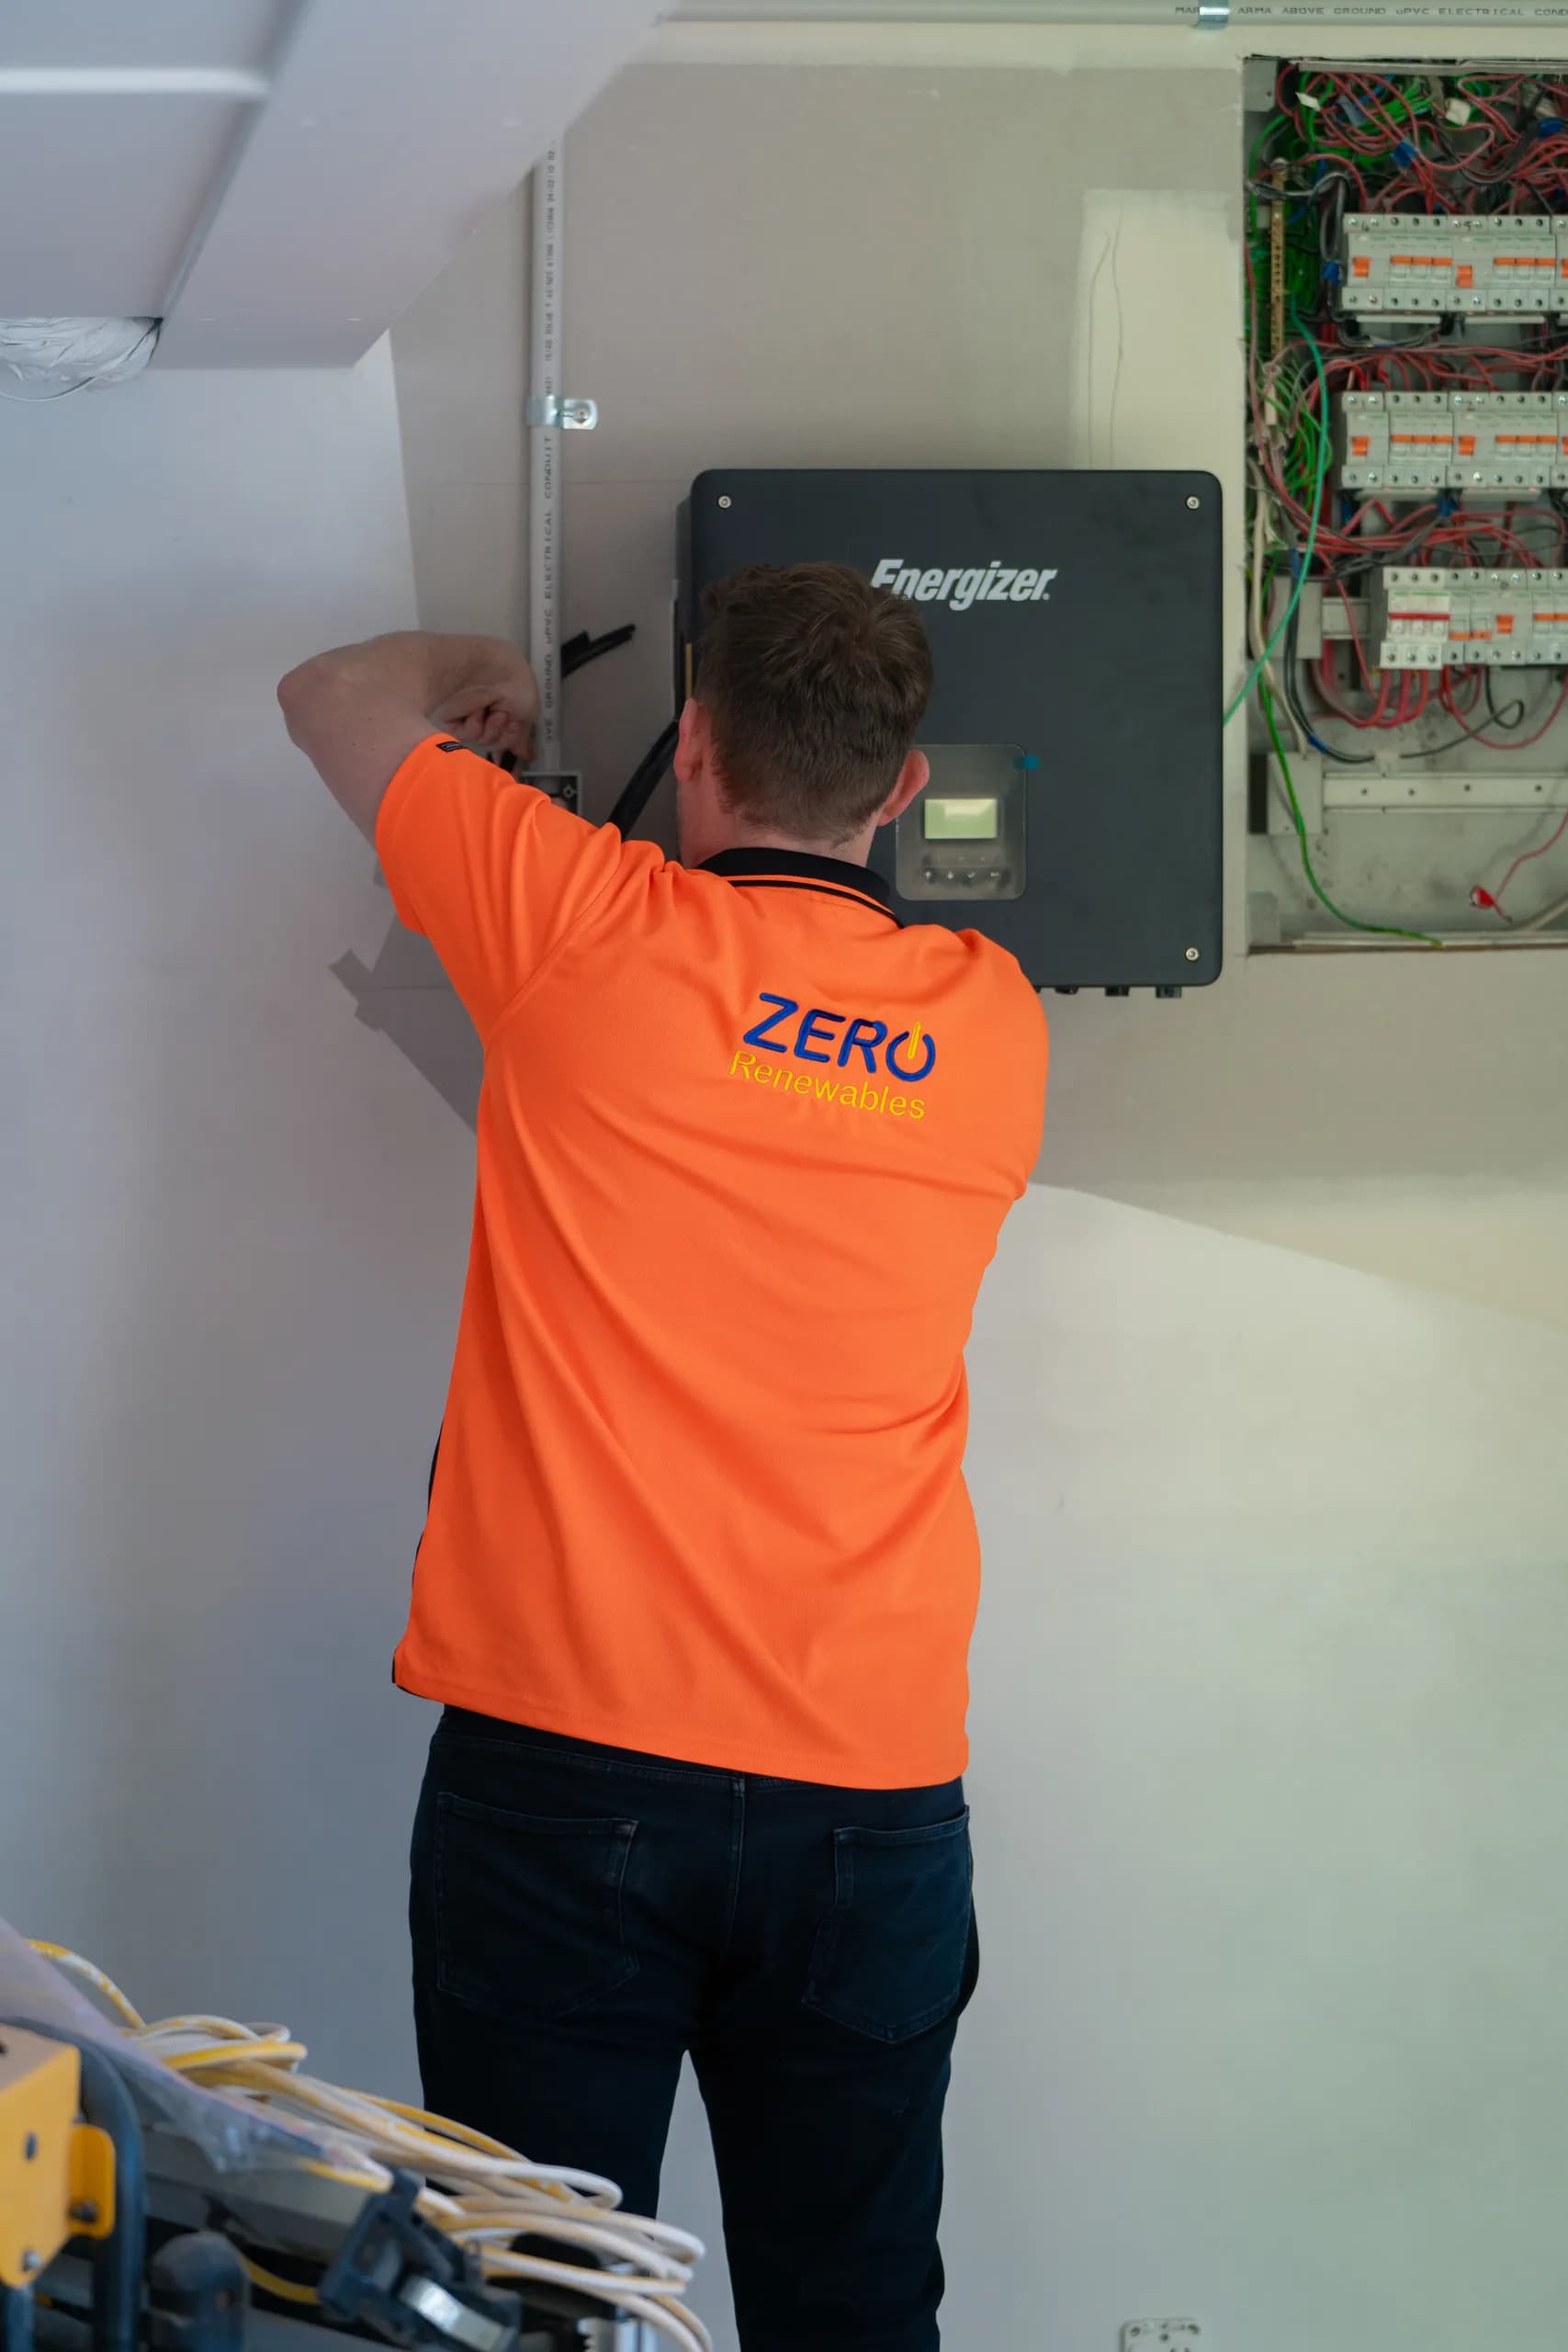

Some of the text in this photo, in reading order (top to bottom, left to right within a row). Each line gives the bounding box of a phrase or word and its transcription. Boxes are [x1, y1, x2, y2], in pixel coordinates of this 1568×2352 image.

[1237, 6, 1271, 15] ARMA
[1282, 6, 1324, 15] ABOVE
[1334, 6, 1386, 15] GROUND
[1395, 7, 1430, 16] uPVC
[1438, 7, 1525, 16] ELECTRICAL
[543, 435, 552, 500] CONDUIT
[543, 512, 552, 599] ELECTRICAL
[543, 653, 553, 708] GROUND
[742, 992, 936, 1081] ZERO
[729, 1050, 927, 1119] Renewables
